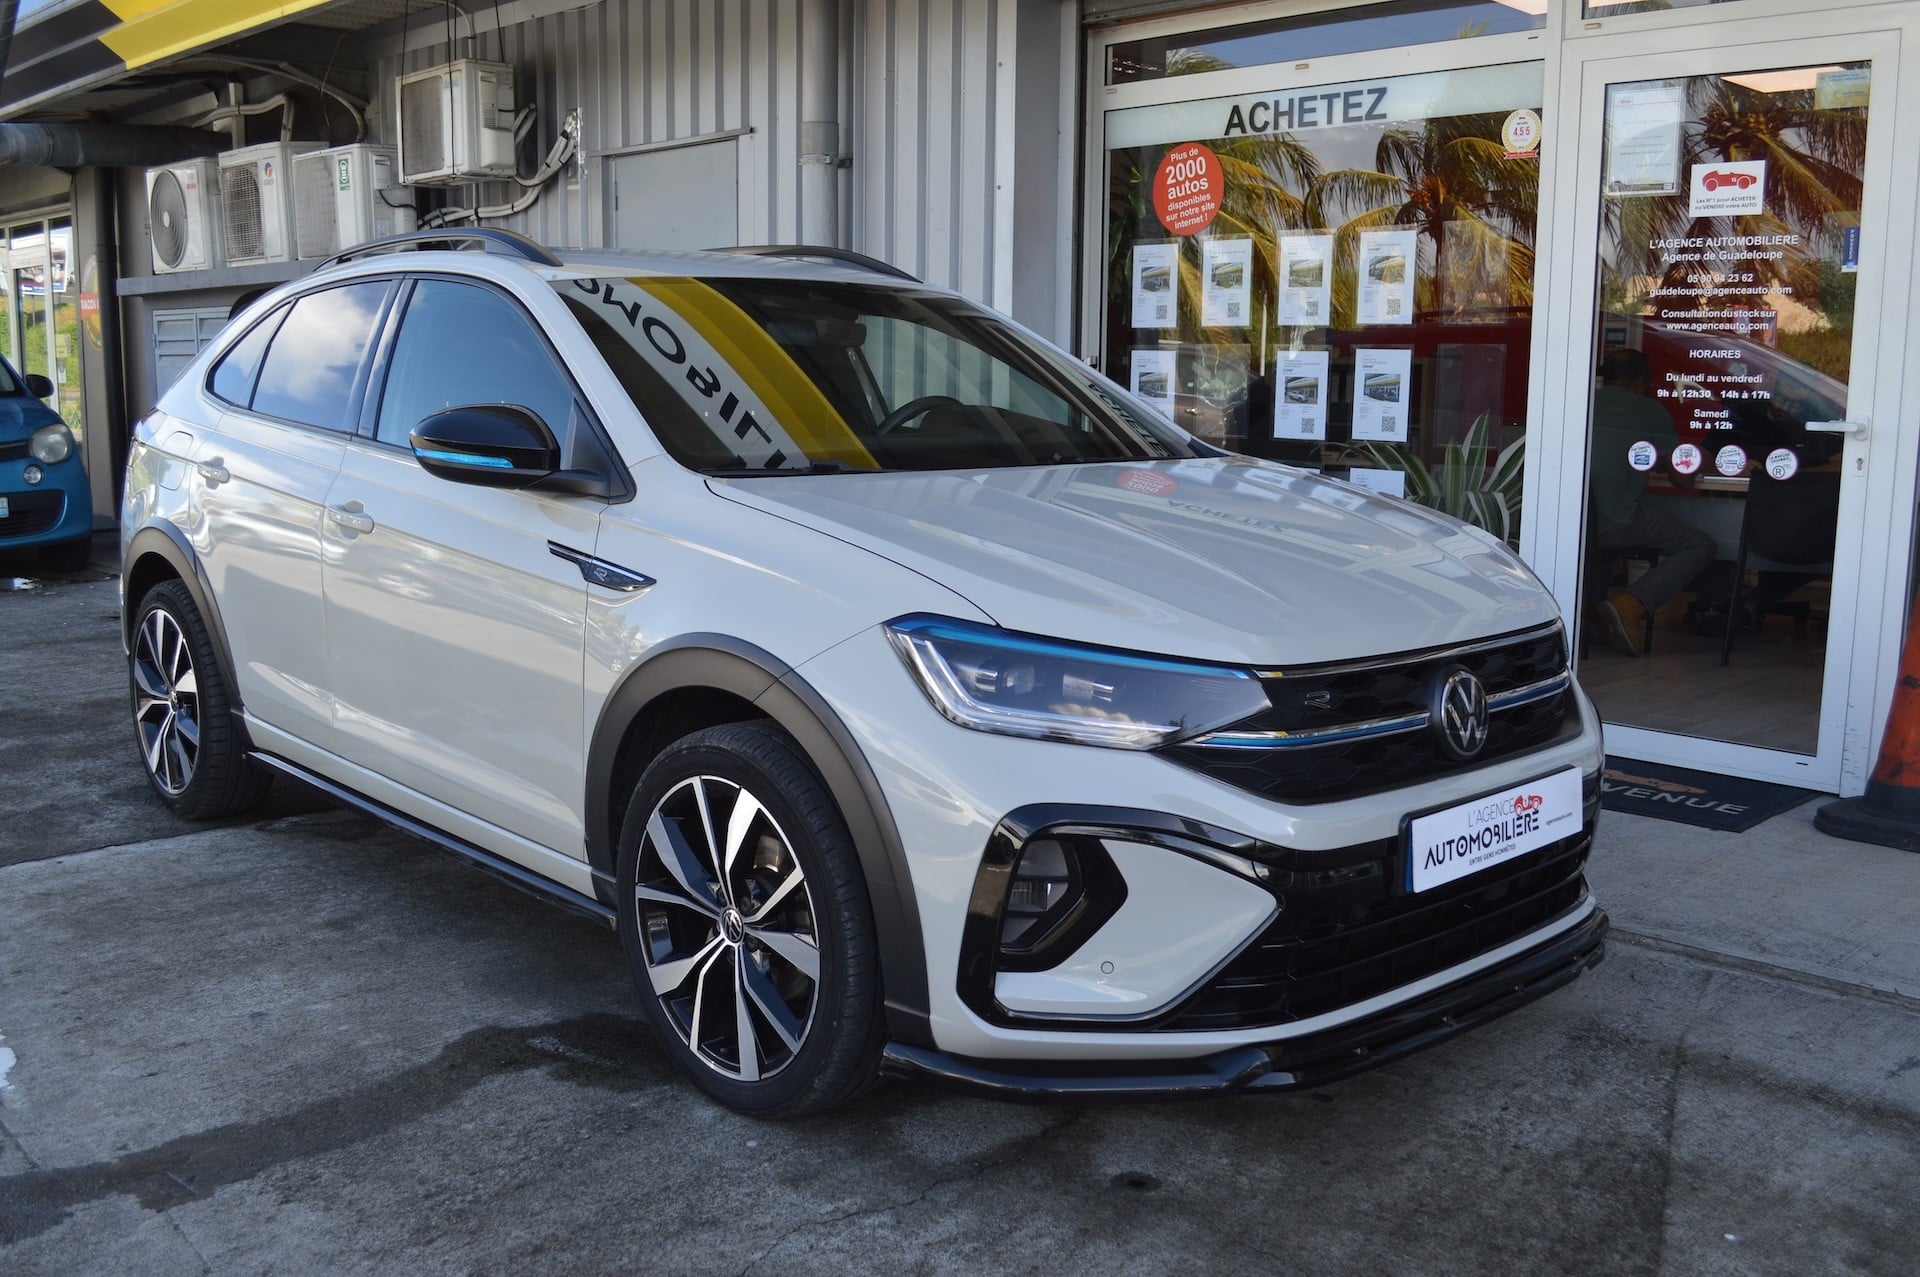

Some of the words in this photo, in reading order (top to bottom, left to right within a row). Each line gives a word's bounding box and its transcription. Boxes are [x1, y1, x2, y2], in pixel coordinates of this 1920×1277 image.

[1224, 87, 1388, 137] ACHETEZ
[1170, 151, 1188, 162] Plus
[1189, 148, 1199, 157] de
[1165, 156, 1207, 185] 2000
[1167, 177, 1209, 200] autos
[1167, 193, 1212, 212] disponibles
[1165, 213, 1179, 222] sur
[1179, 207, 1200, 218] notre
[1200, 202, 1216, 213] site
[1174, 214, 1204, 230] internet
[1649, 237, 1704, 249] L'AGENCE
[1706, 234, 1799, 247] AUTOMOBILIERE
[1662, 251, 1701, 263] Agence
[1703, 251, 1716, 261] de
[1718, 250, 1783, 262] Guadeloupe
[1687, 274, 1699, 283] 05
[1728, 274, 1740, 282] 23
[1742, 273, 1754, 282] 62
[1649, 287, 1792, 298] guadeloupe@agenceauto.com
[1666, 322, 1769, 332] www.agenceauto.com
[1689, 349, 1742, 359] HORAIRES
[1666, 373, 1679, 382] Du
[1681, 373, 1704, 382] lundi
[1706, 374, 1718, 382] au
[1720, 374, 1763, 383] vendredi
[1657, 389, 1669, 398] 9h
[1671, 389, 1680, 398] à
[1681, 389, 1711, 398] 12h30
[1720, 390, 1739, 399] 14h
[1741, 390, 1748, 399] à
[1751, 390, 1770, 399] 17h
[1693, 408, 1729, 418] Samedi
[1689, 421, 1702, 429] 9h
[1704, 421, 1712, 429] à
[1714, 421, 1733, 430] 12h
[1468, 797, 1515, 828] L'AGENCE
